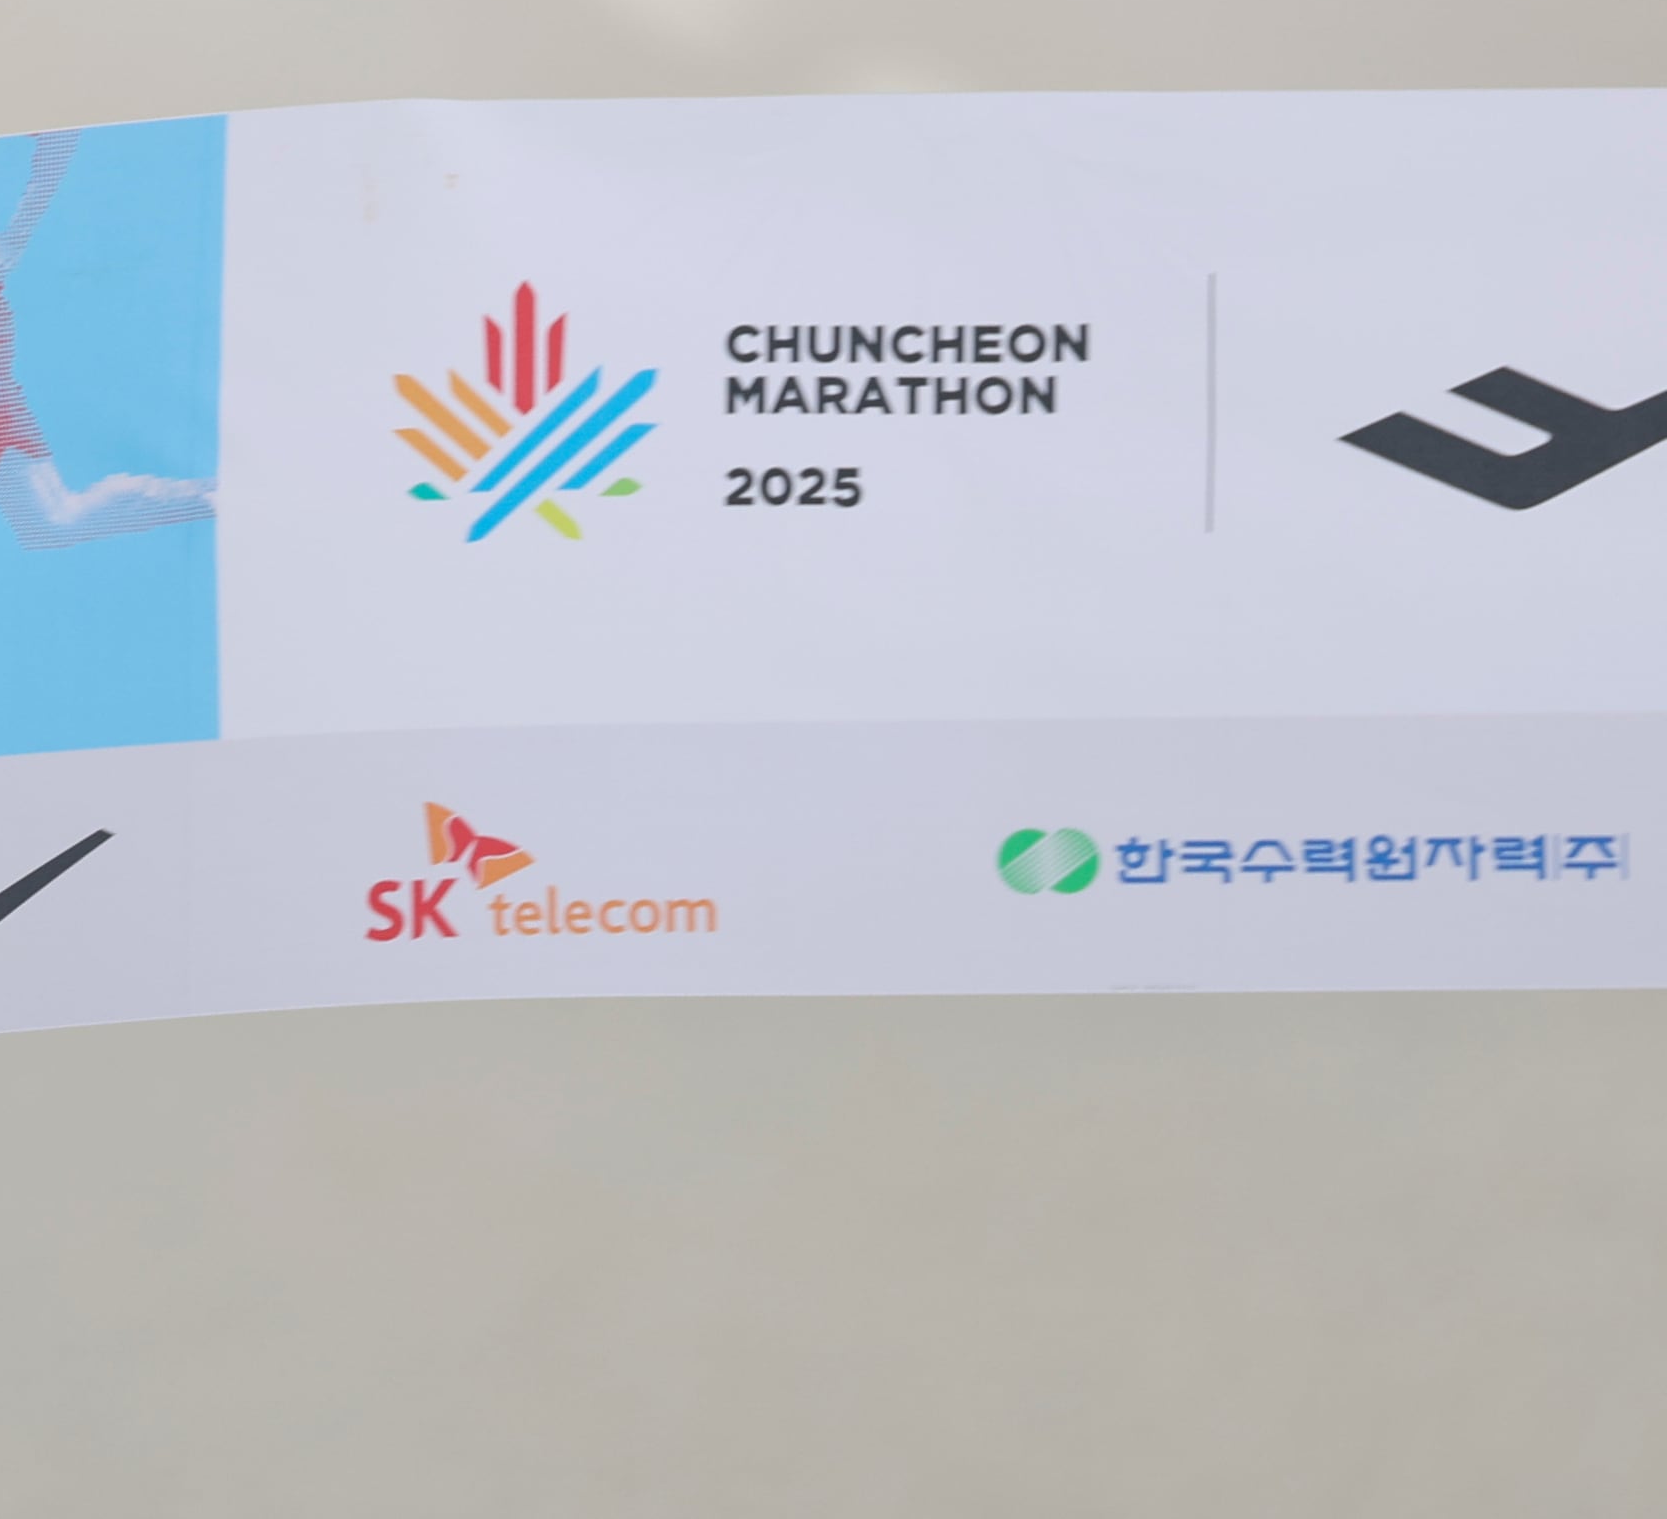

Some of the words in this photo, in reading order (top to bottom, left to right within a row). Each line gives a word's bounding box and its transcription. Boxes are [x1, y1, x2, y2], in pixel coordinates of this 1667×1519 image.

[723, 323, 1092, 365] CHUNCHEON
[723, 375, 1059, 417] MARATHON
[723, 467, 865, 508] 2025
[364, 877, 461, 942] SK
[487, 885, 718, 936] telecom
